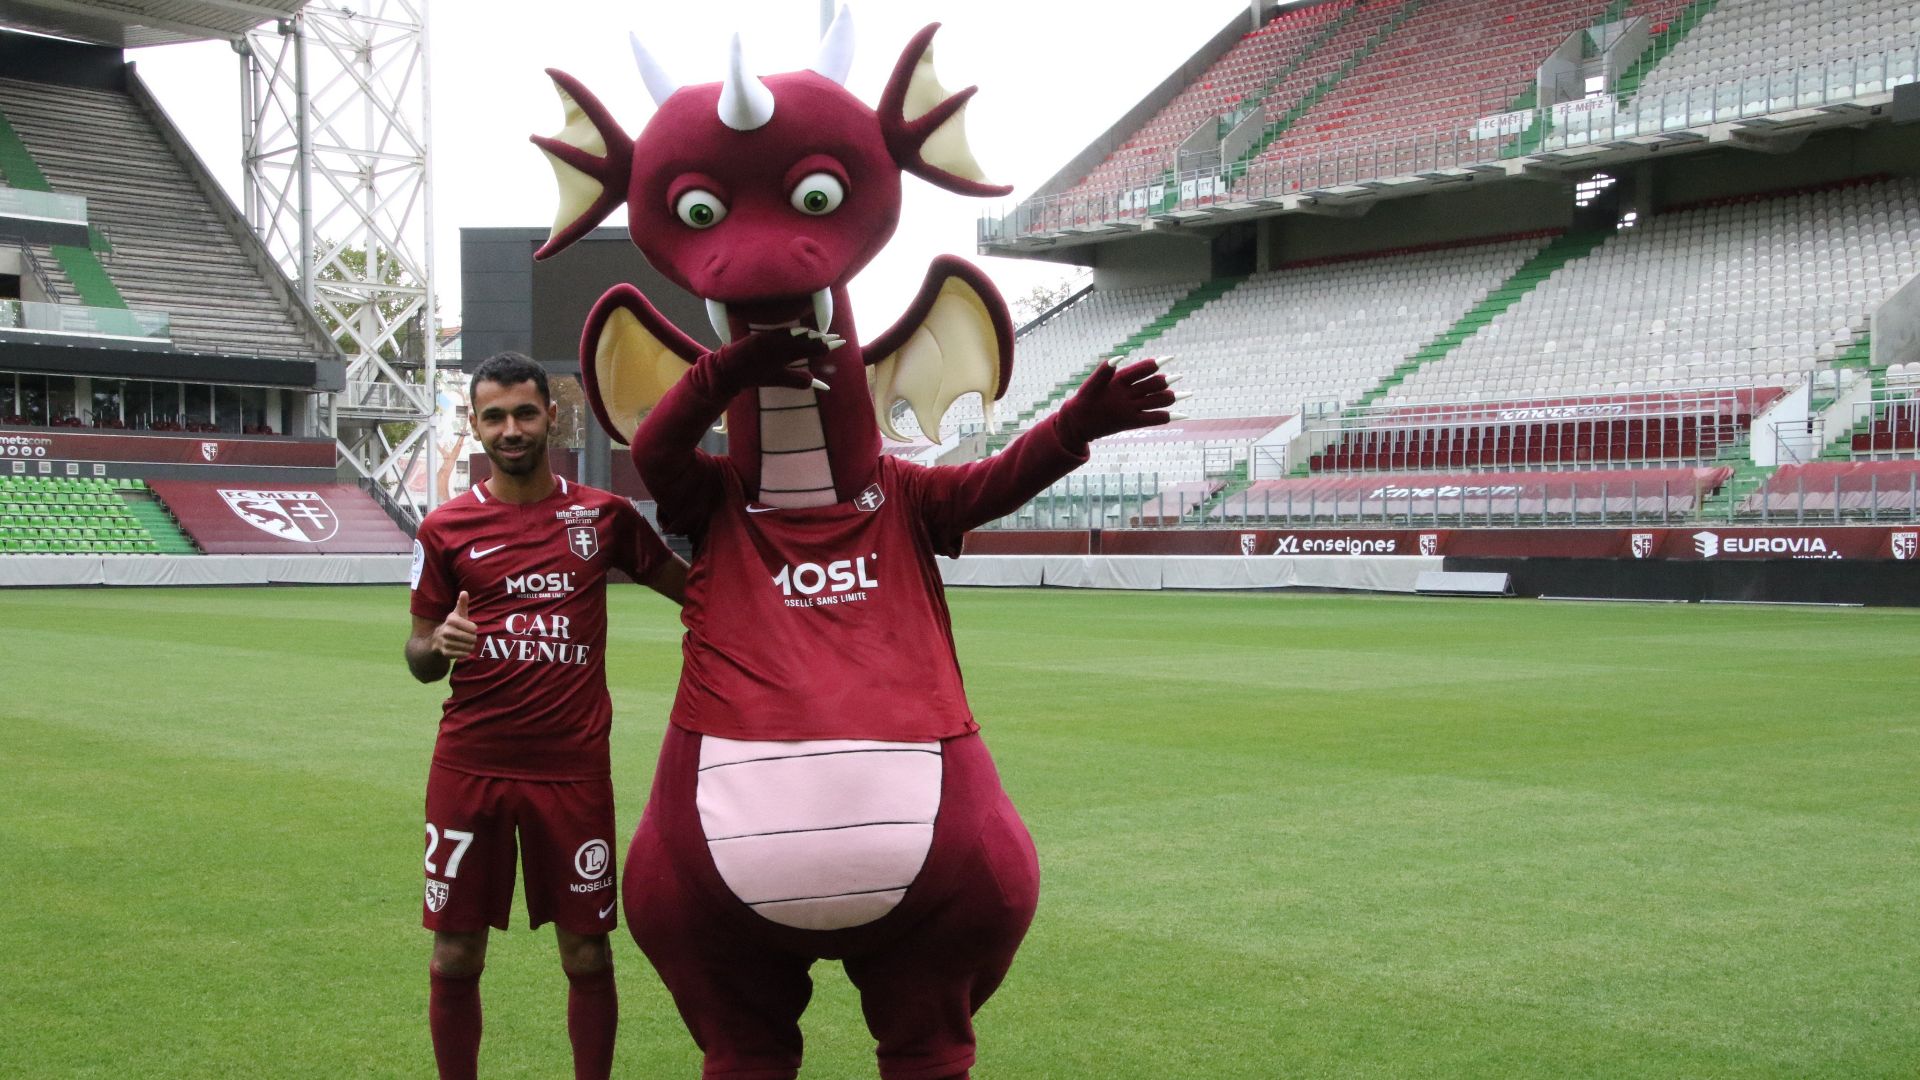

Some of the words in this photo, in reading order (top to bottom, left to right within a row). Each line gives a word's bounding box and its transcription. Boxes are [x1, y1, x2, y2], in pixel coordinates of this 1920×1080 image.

[225, 491, 250, 499] FC
[1273, 535, 1299, 556] XL
[1302, 536, 1396, 556] enseignes
[1723, 537, 1827, 553] EUROVIA
[505, 572, 575, 594] MOSL
[785, 598, 814, 608] OSELLE
[817, 595, 838, 606] SANS
[840, 591, 867, 603] LIMITE
[505, 613, 571, 639] CAR
[479, 635, 590, 665] AVENUE
[425, 822, 474, 879] 27
[570, 876, 613, 893] MOSELLE
